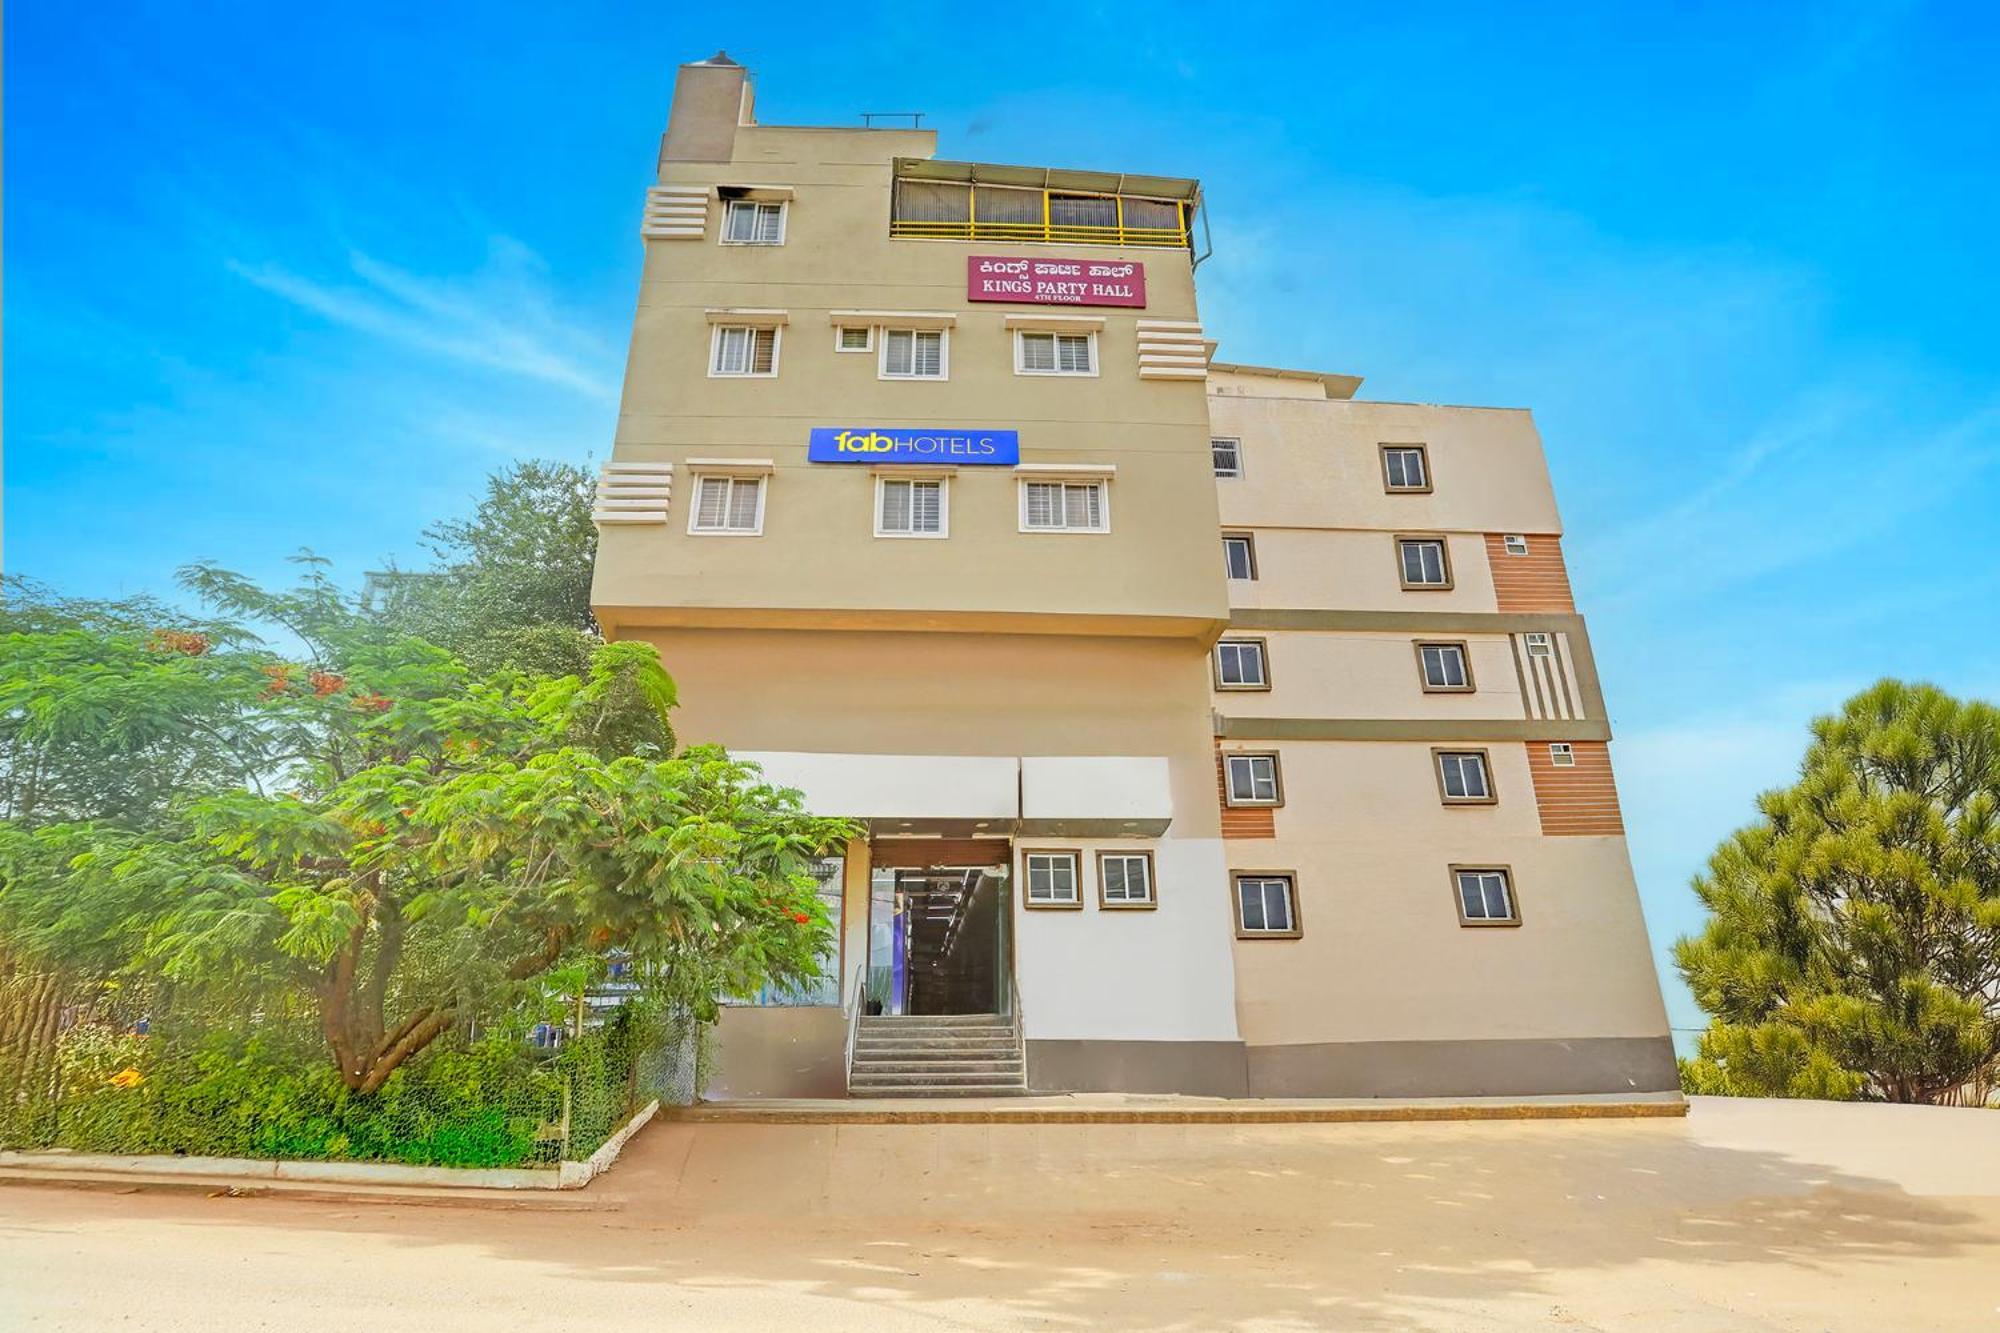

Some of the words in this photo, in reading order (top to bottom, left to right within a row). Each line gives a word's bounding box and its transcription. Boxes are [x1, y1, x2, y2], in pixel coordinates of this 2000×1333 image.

[983, 280, 1032, 294] KINGS
[1036, 281, 1088, 295] PARTY
[1092, 284, 1133, 297] HALL
